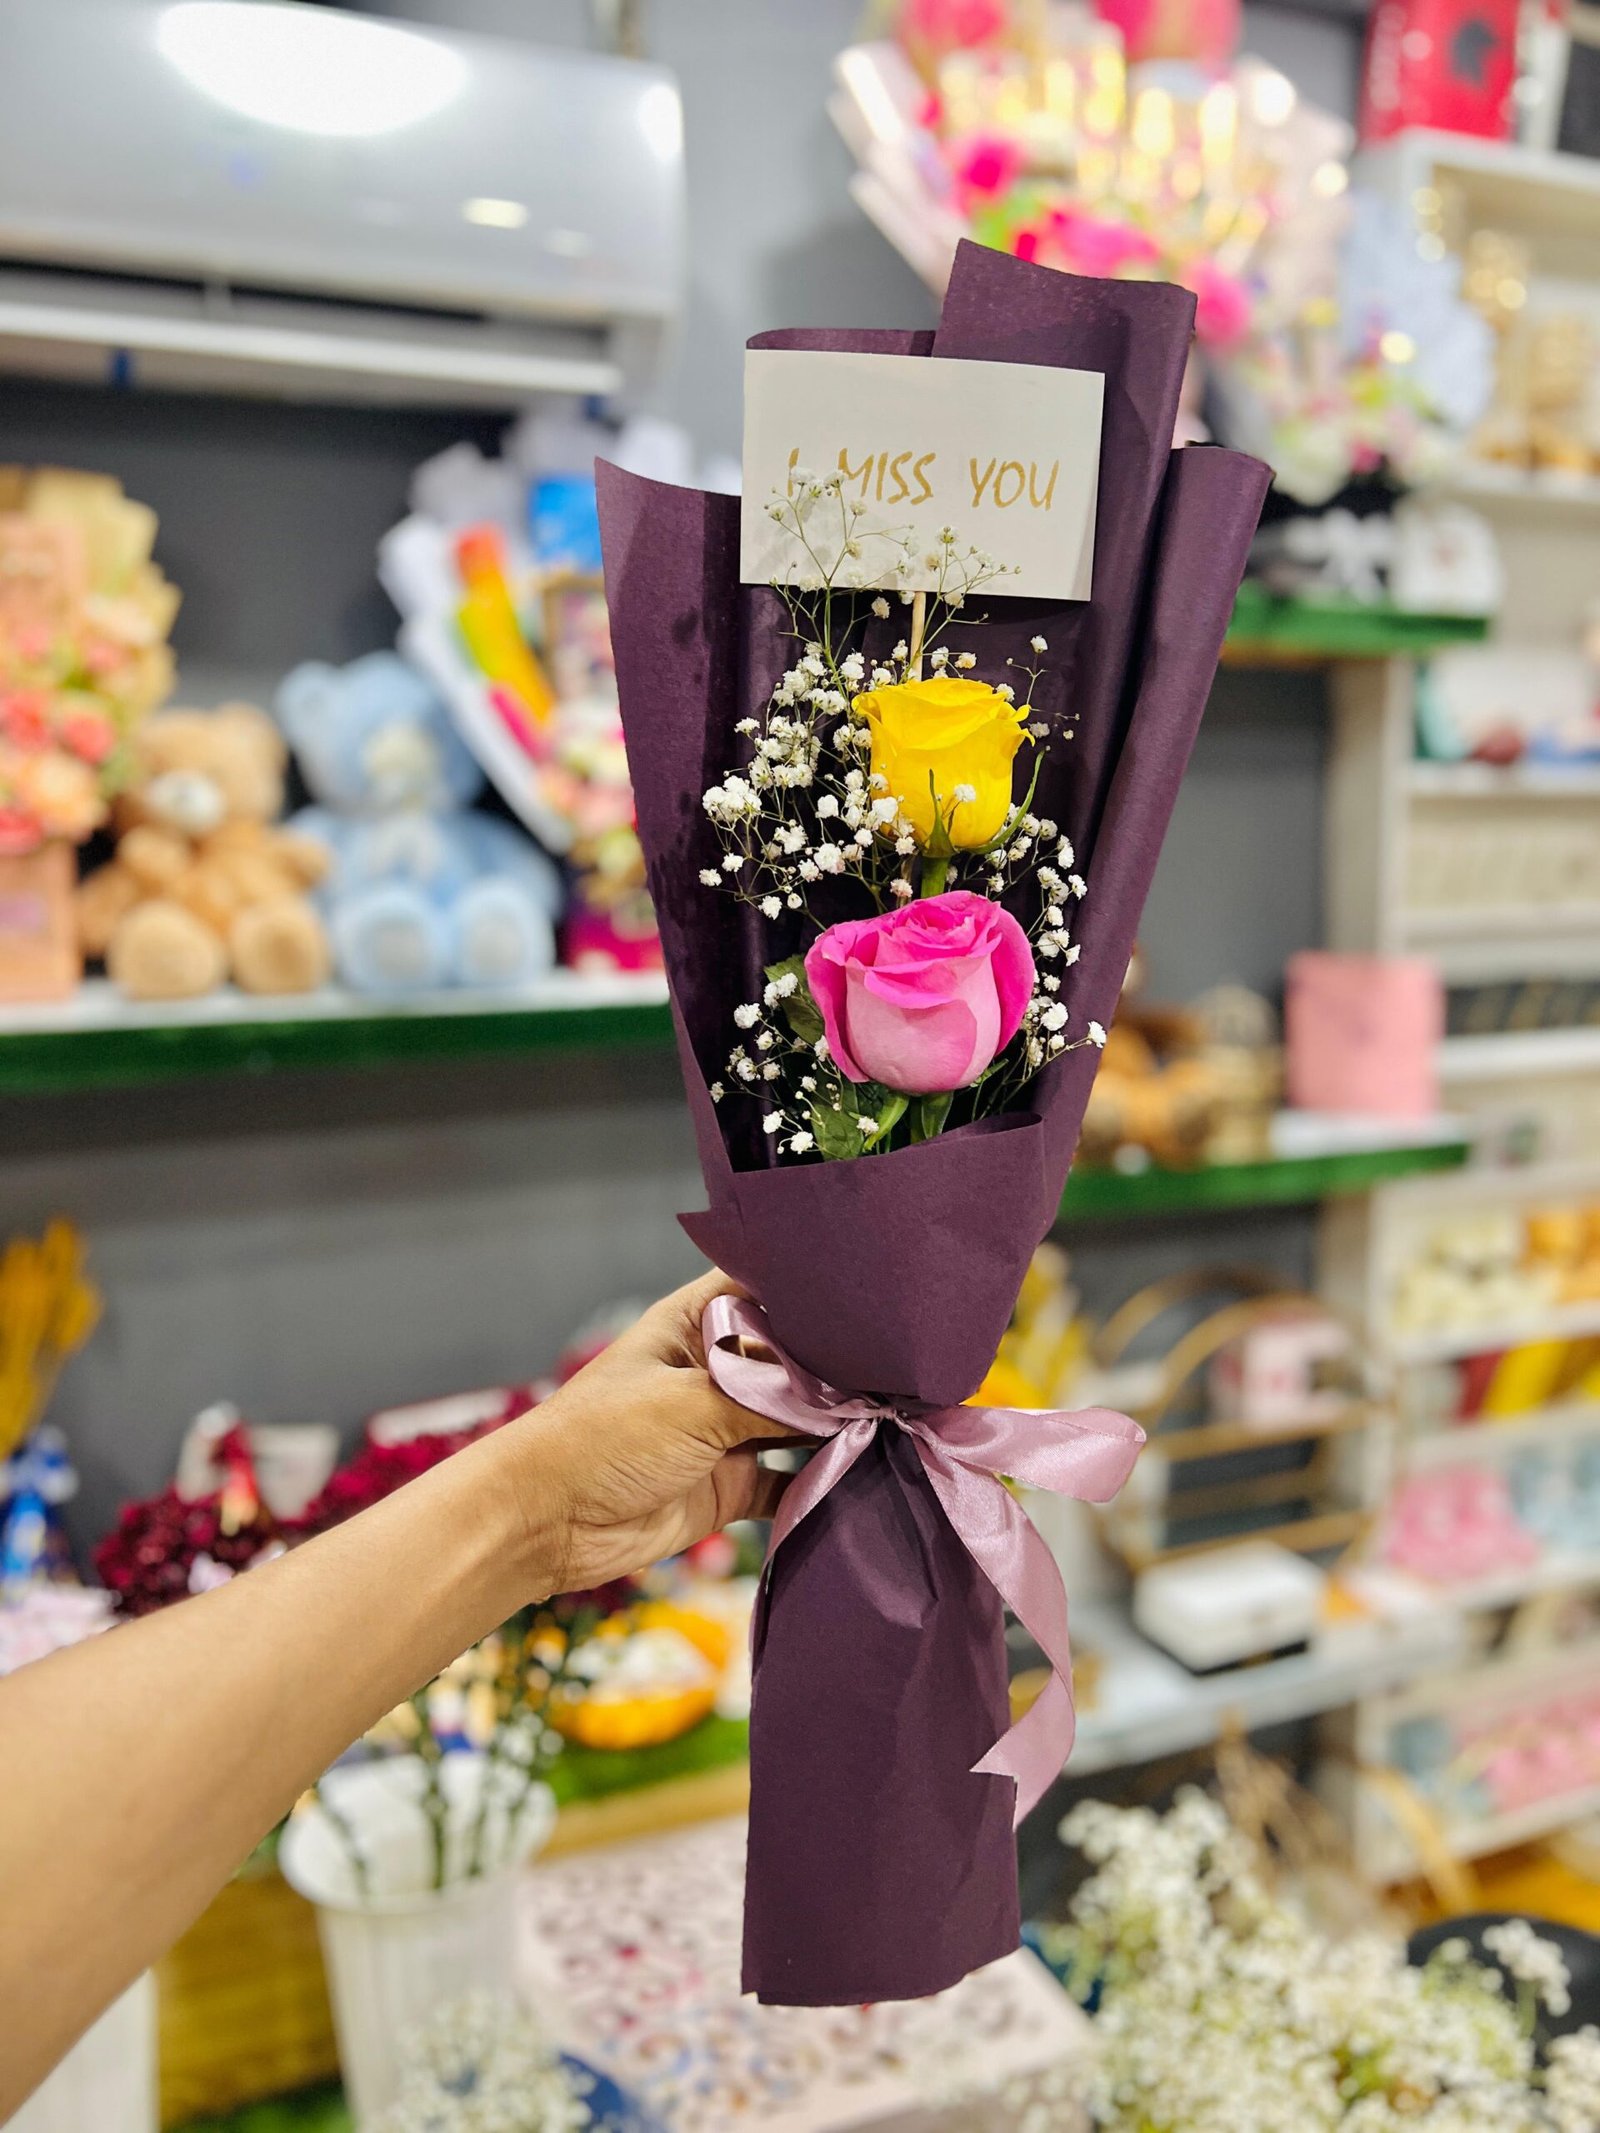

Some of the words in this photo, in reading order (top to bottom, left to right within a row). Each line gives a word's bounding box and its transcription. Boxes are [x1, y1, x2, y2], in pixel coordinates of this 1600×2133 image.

[787, 447, 800, 497] I
[836, 447, 937, 505] MISS
[969, 457, 1060, 511] YOU
